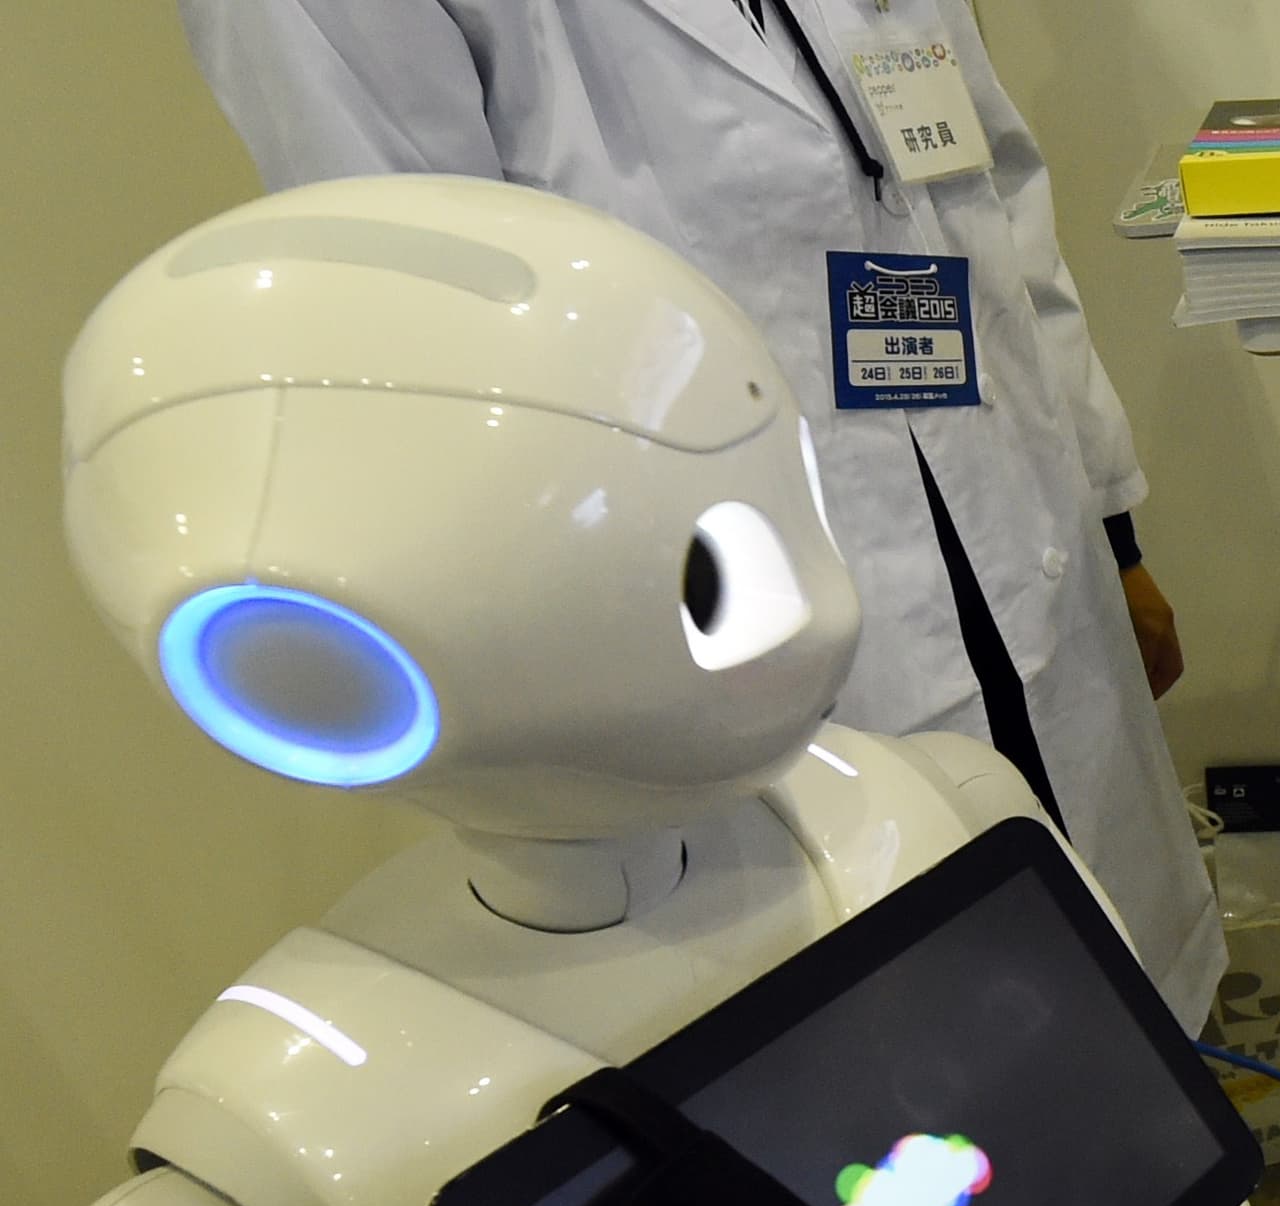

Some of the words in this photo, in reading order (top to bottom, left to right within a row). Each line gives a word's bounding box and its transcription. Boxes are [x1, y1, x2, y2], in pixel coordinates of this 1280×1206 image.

[900, 121, 957, 153] 研究員
[884, 336, 934, 355] 出演者
[861, 367, 886, 380] 24日
[899, 366, 922, 380] 25日
[933, 366, 955, 380] 26日
